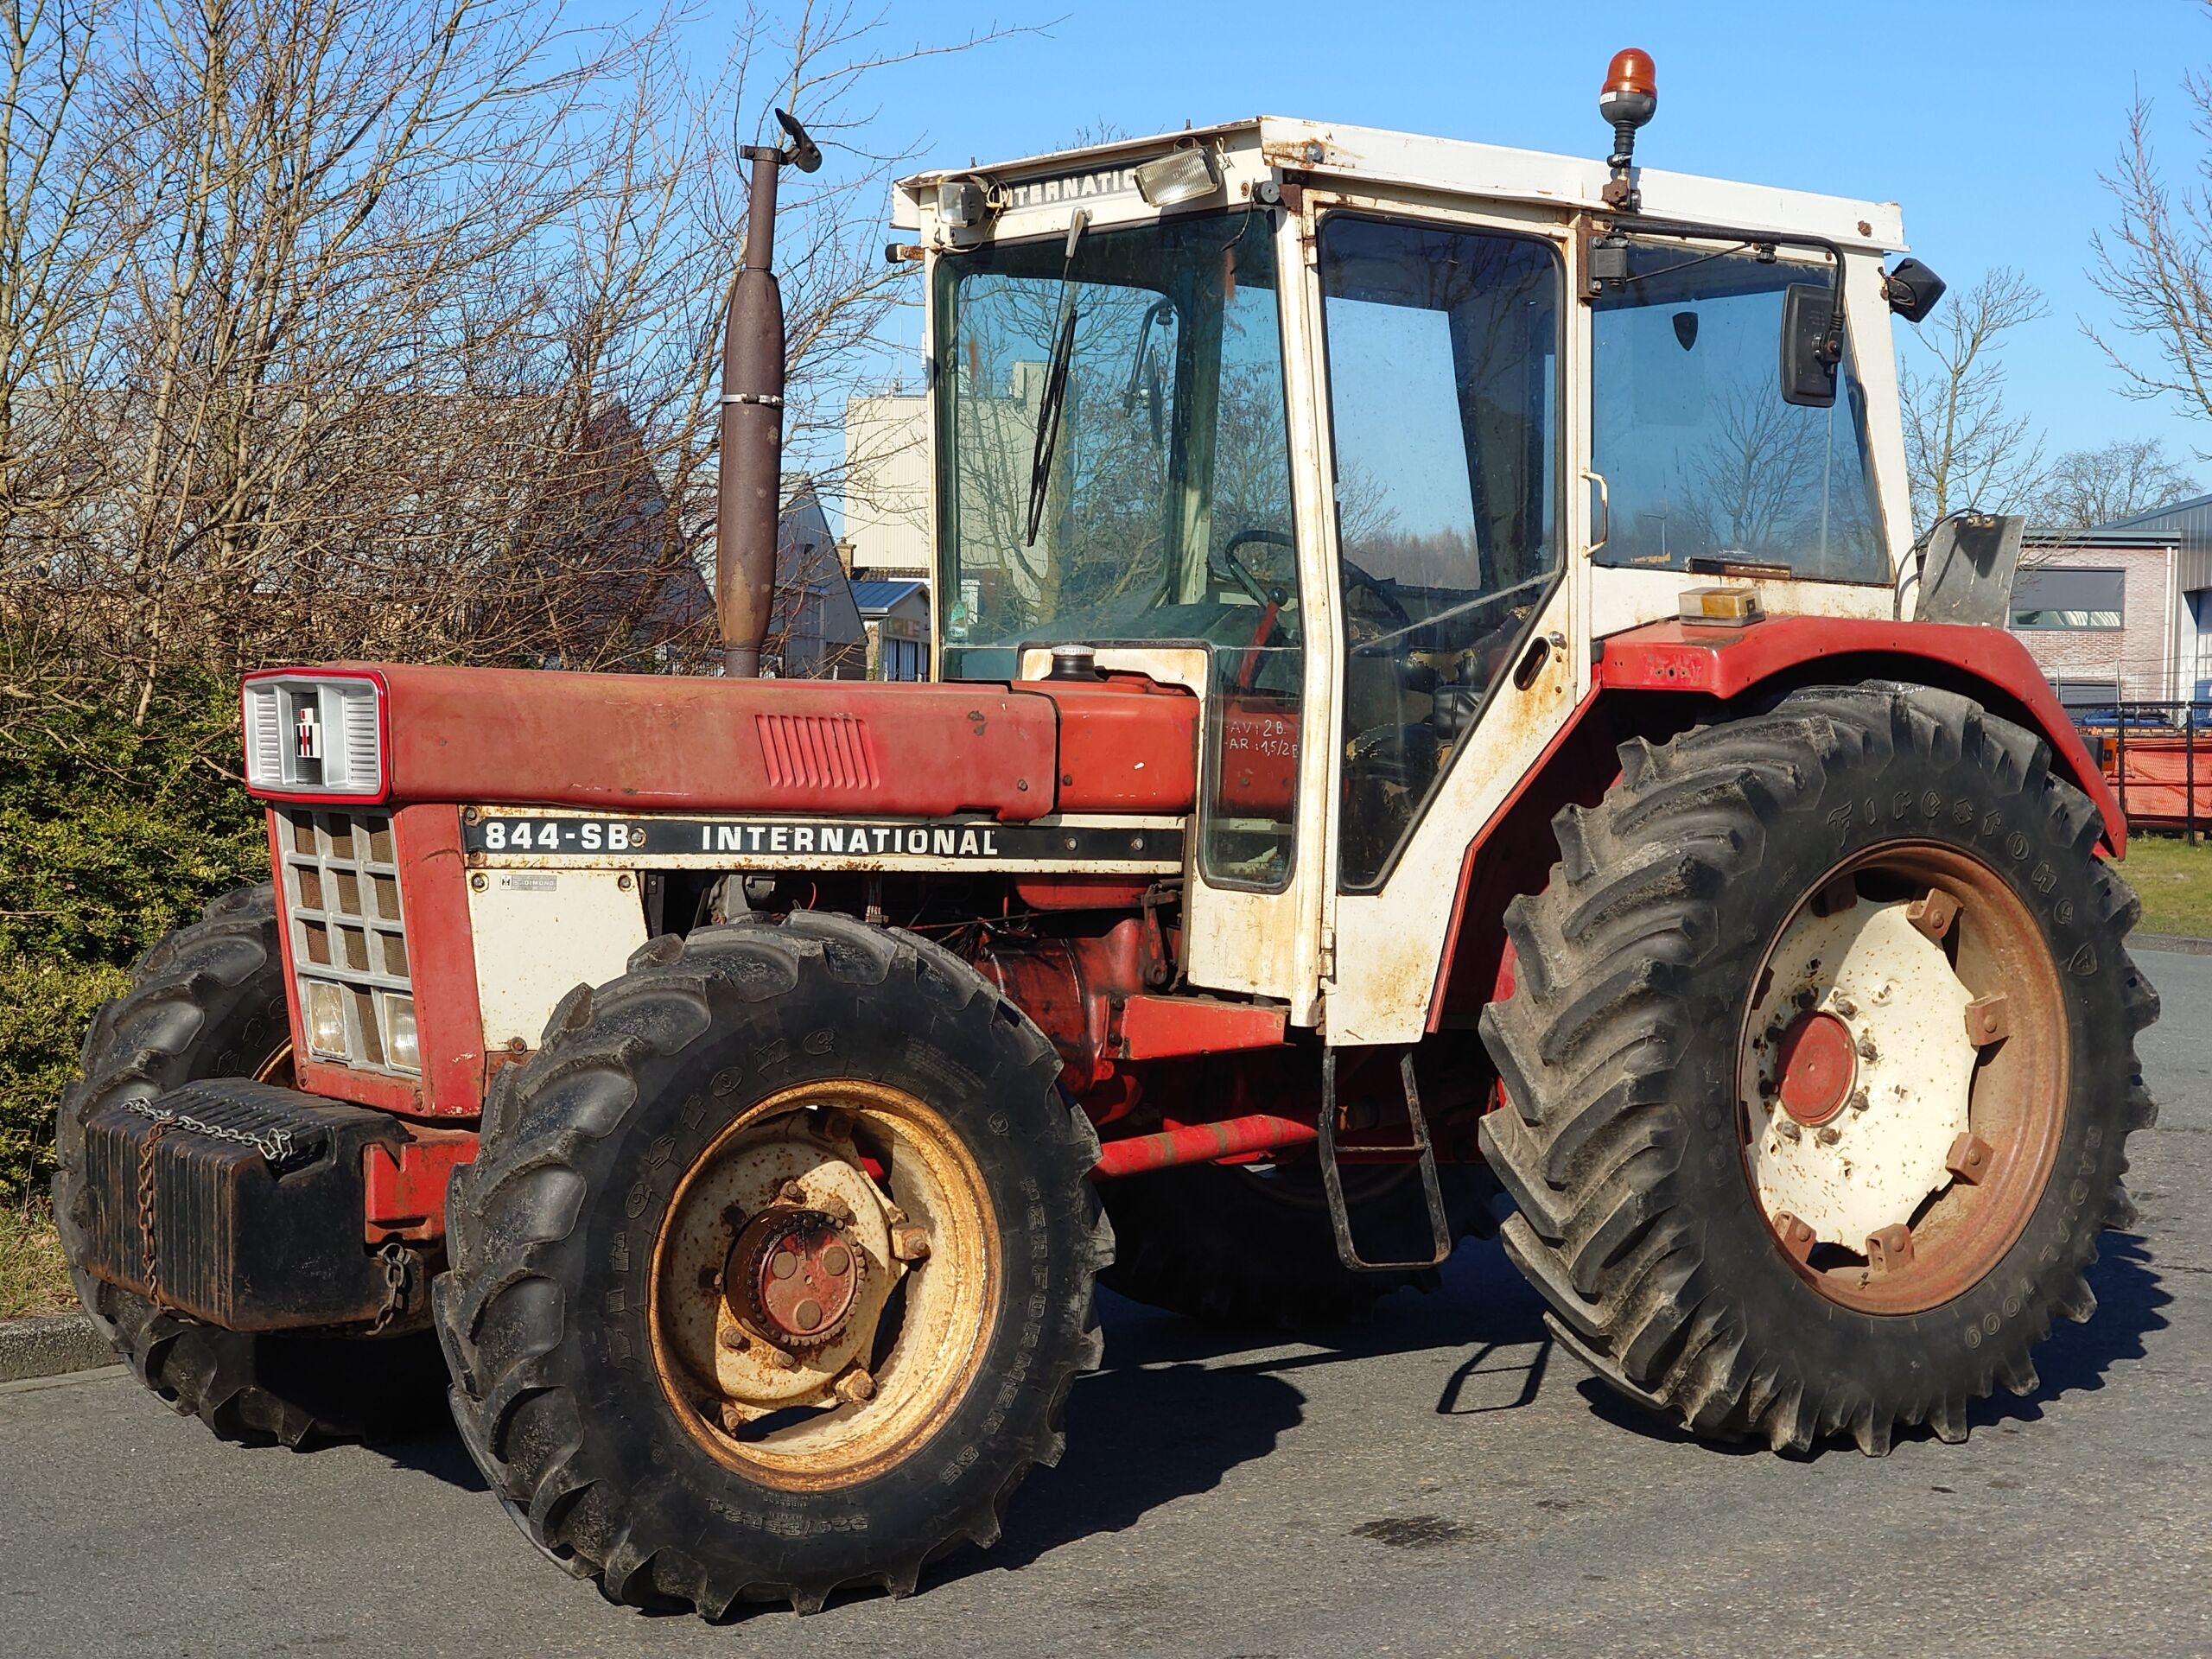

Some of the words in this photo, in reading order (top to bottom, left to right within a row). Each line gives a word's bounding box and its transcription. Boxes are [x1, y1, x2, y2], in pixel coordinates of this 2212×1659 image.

[1000, 168, 1136, 207] NTERNATIO
[486, 823, 630, 850] 844-SB
[702, 825, 999, 855] INTERNATIONAL
[1826, 788, 2075, 926] Firestone
[977, 1177, 1050, 1436] PERFORMER
